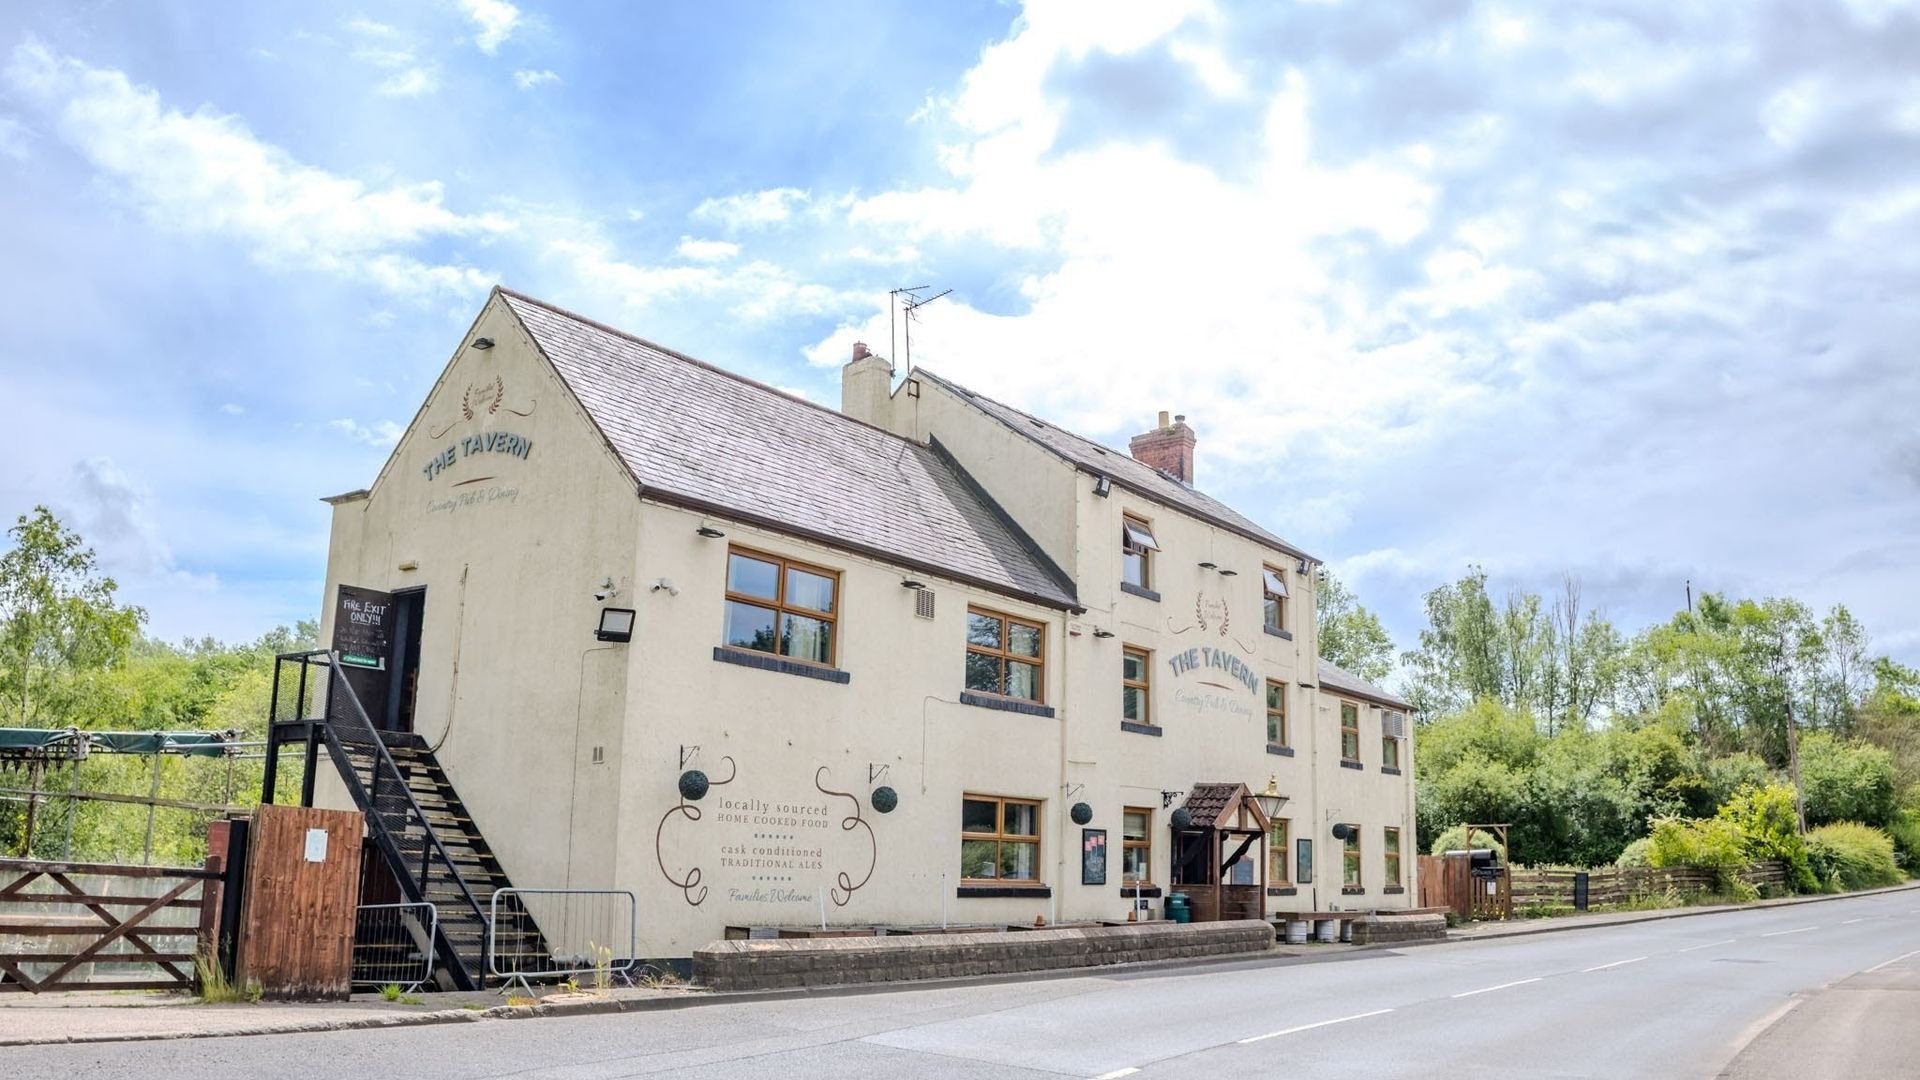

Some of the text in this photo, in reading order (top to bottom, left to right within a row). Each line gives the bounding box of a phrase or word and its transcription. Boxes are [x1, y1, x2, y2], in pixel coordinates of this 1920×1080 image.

[422, 431, 533, 482] THE TAVERN
[343, 599, 386, 615] FIRE EXIT
[1168, 646, 1259, 696] THE TAVERN
[719, 797, 828, 816] locally sourced
[718, 813, 828, 829] HOME COOKED FOOD
[721, 845, 822, 857] cask conditioned
[721, 858, 823, 870] TRADITIONAL ALES
[728, 888, 813, 902] Families Welcome
